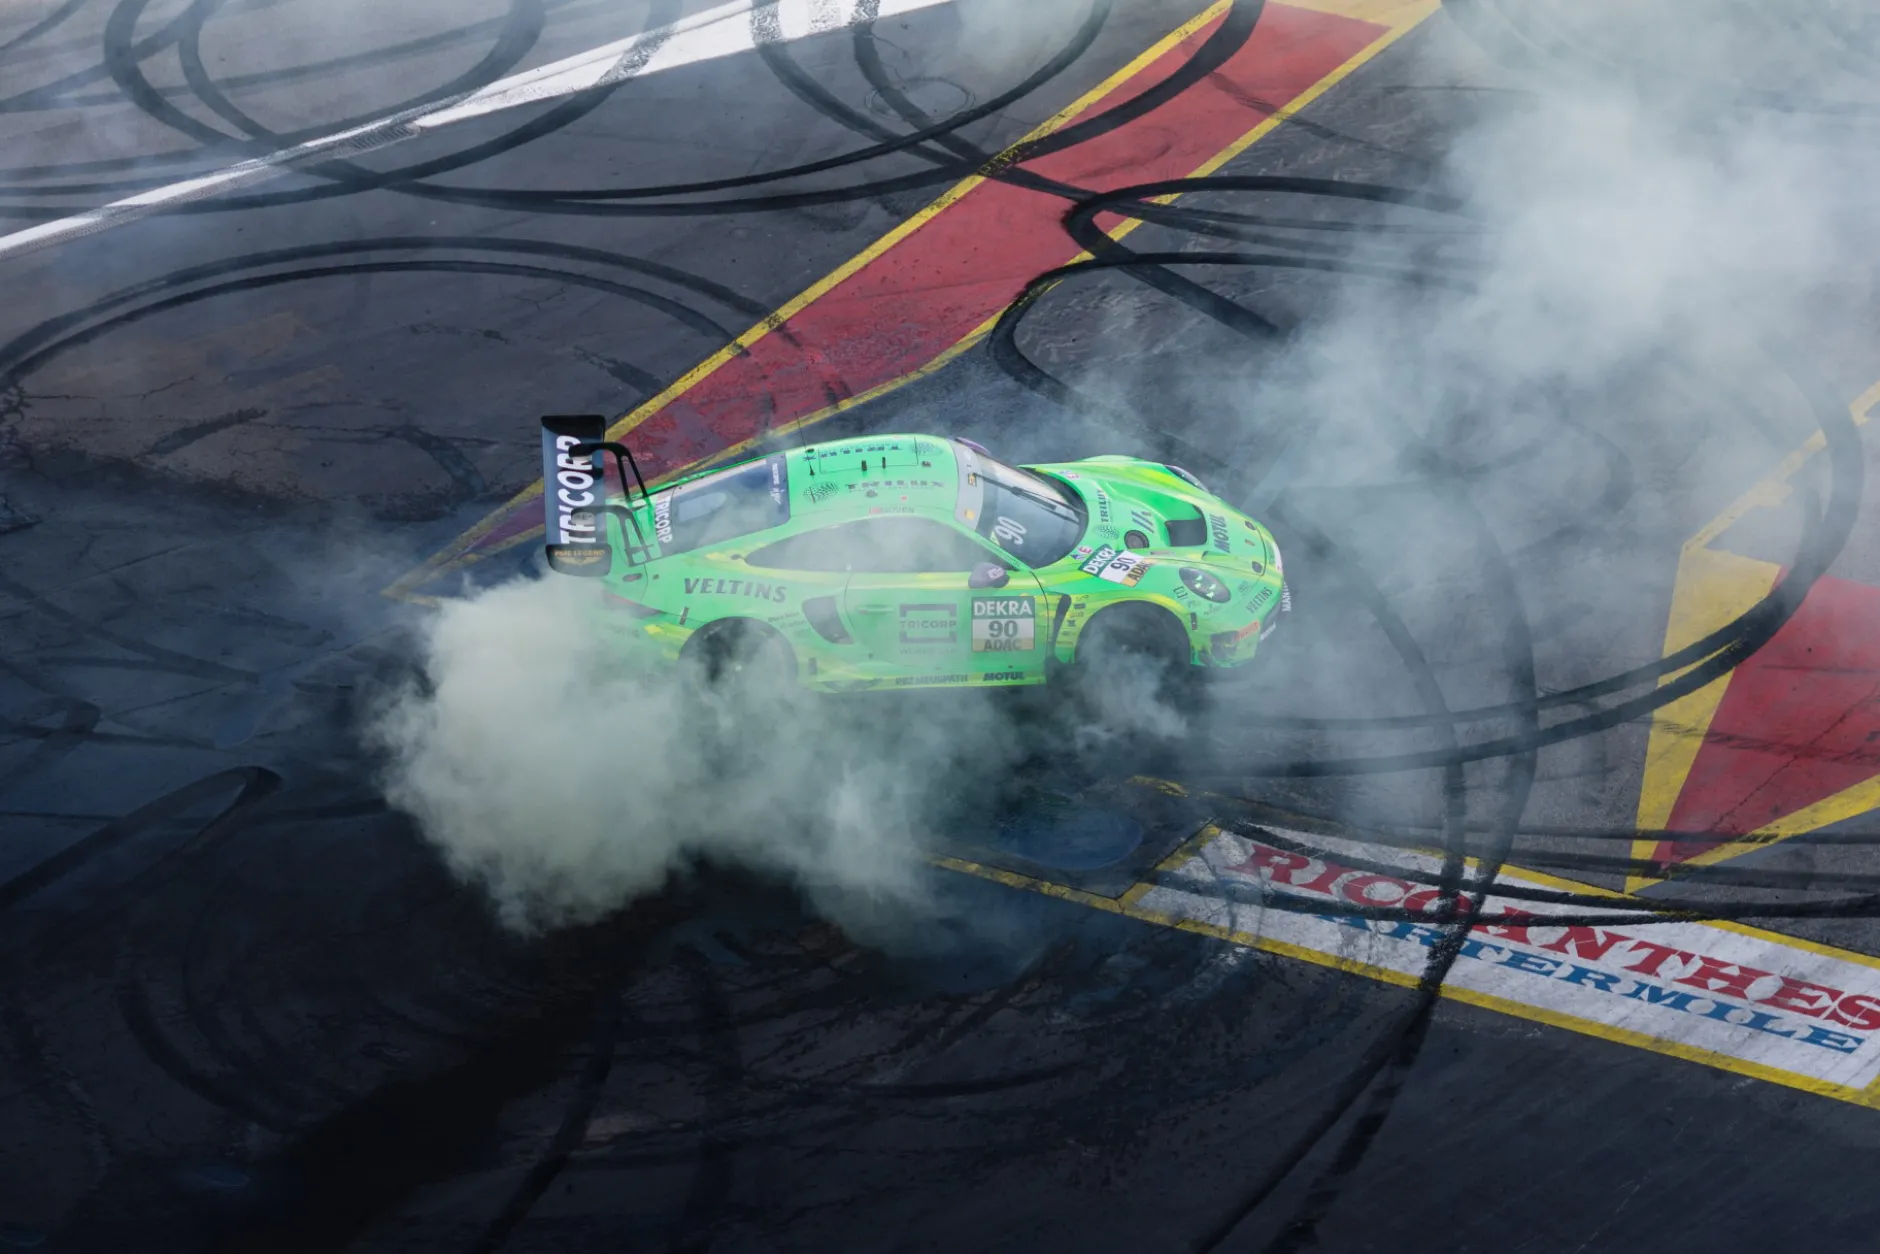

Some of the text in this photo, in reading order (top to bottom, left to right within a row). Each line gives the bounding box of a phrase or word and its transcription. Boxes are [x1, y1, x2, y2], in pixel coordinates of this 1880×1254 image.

[654, 495, 673, 543] TRICORP
[995, 516, 1027, 545] 90
[1210, 515, 1231, 553] MOTUL
[1110, 557, 1136, 571] 90
[685, 578, 787, 602] VELTINS
[974, 601, 1032, 616] DEKRA
[900, 621, 956, 629] TRICORP
[988, 620, 1018, 638] 90
[984, 640, 1022, 651] ADAC
[983, 672, 1024, 681] MOTUL
